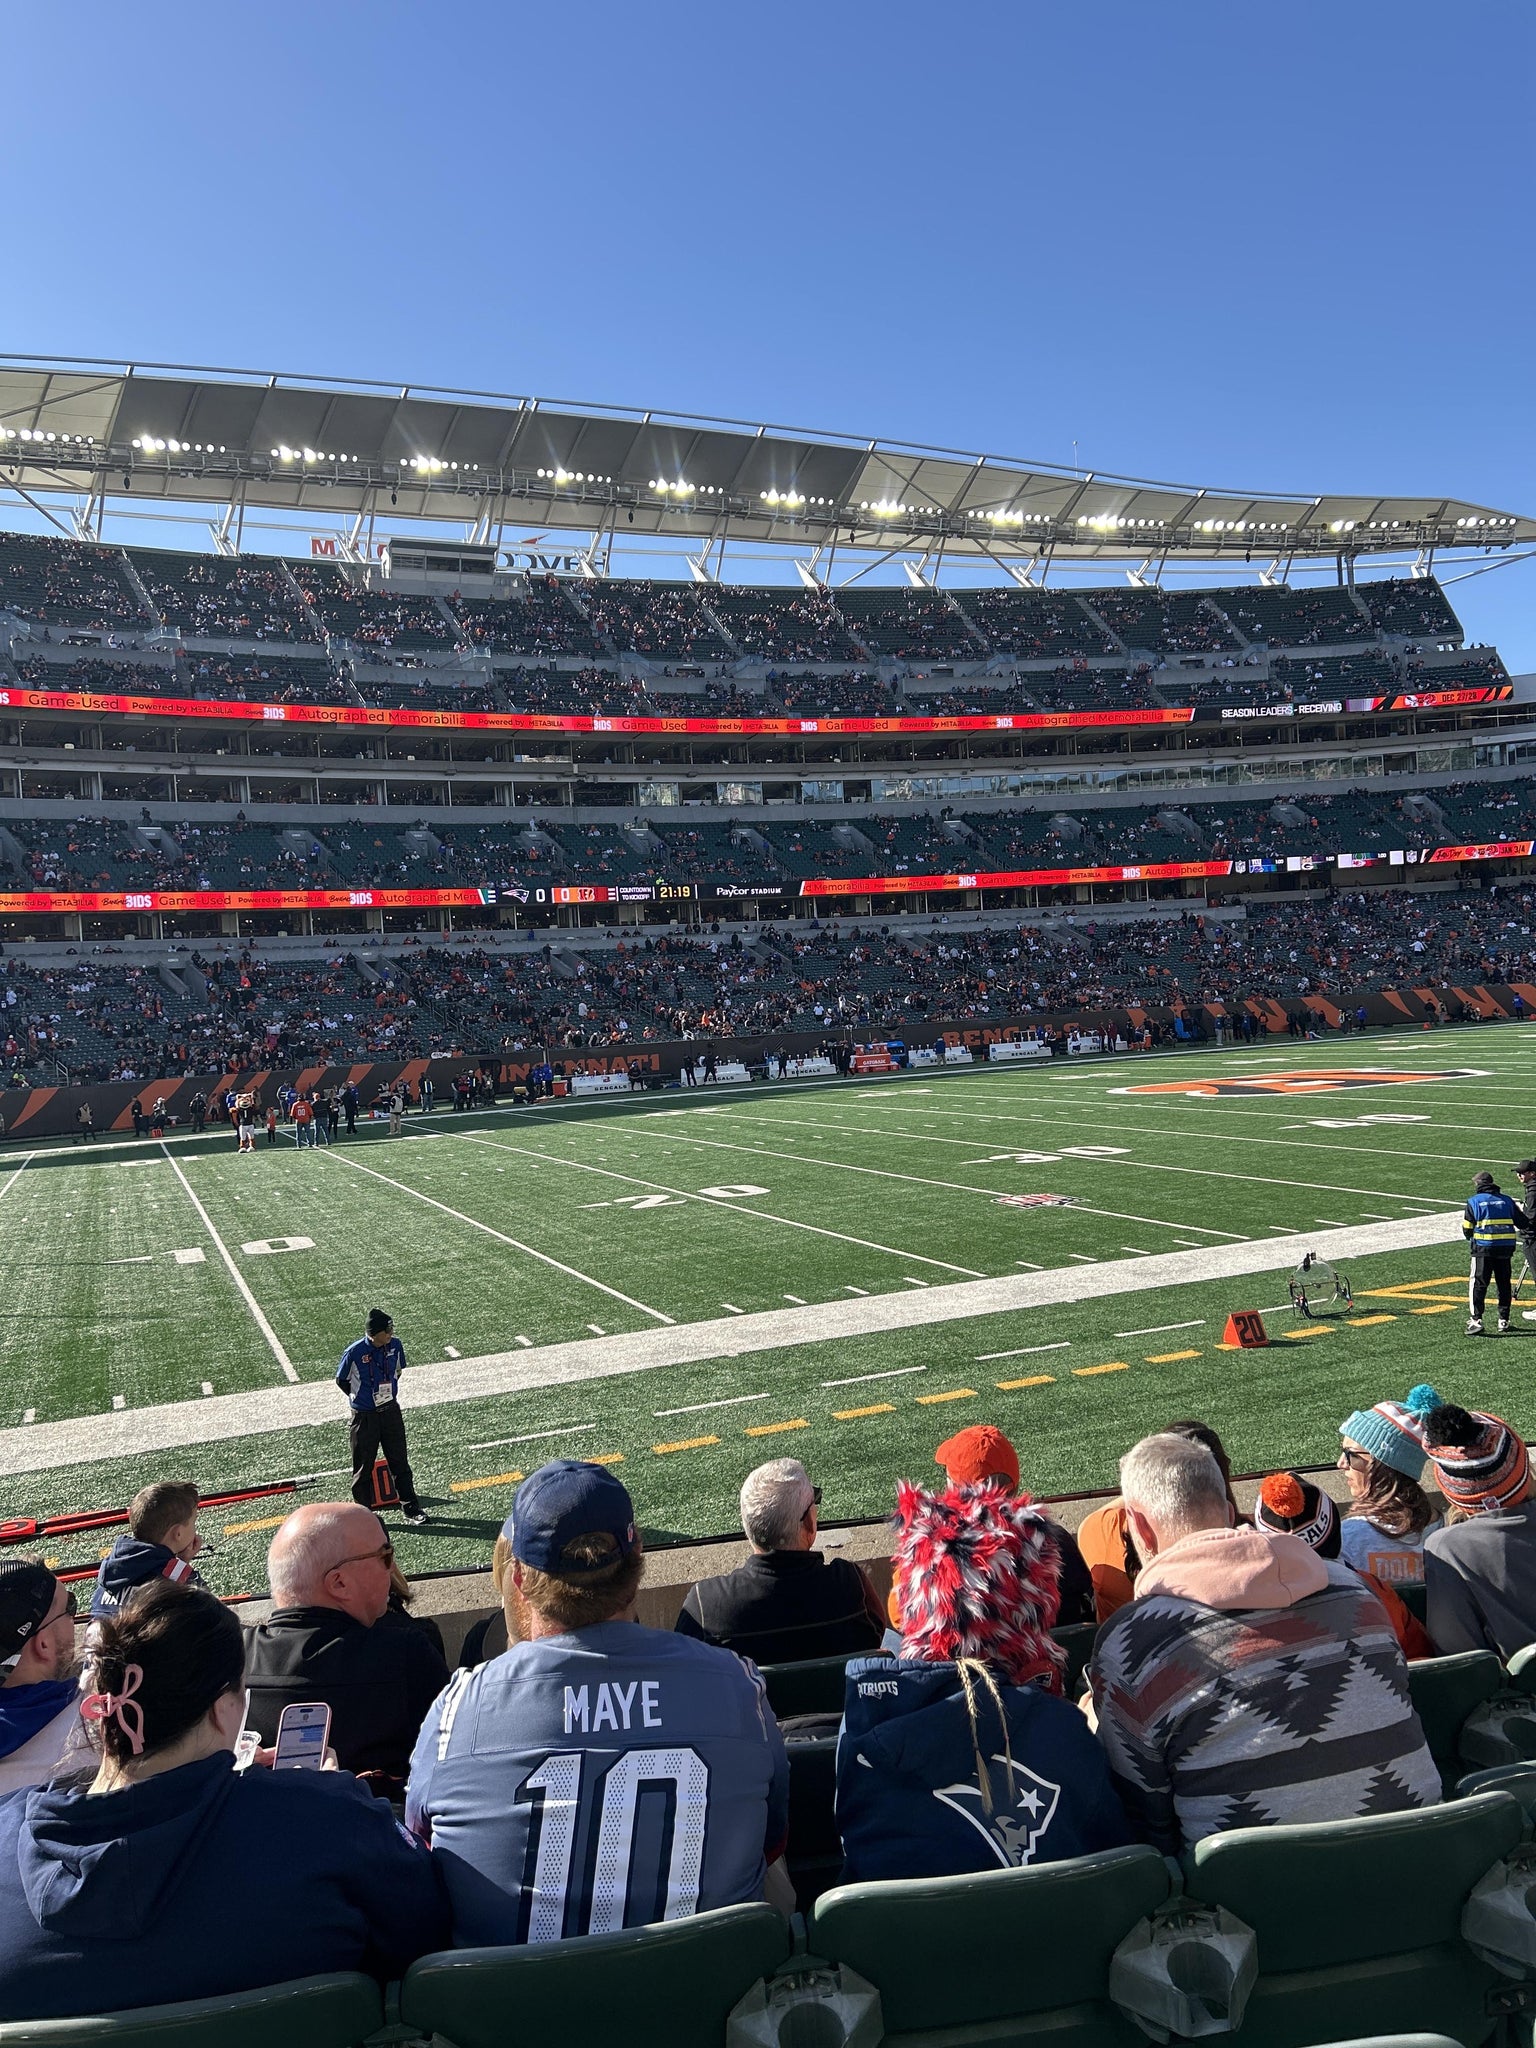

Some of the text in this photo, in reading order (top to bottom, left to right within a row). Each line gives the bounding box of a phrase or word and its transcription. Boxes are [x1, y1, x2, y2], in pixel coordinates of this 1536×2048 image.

[29, 693, 119, 710] Game-Used
[1442, 694, 1455, 703] DEC
[132, 702, 174, 711] Powered
[176, 704, 187, 713] by
[1221, 706, 1255, 718] SEASON
[1256, 704, 1293, 717] LEADERS
[1299, 702, 1343, 714] RECEIVING
[297, 708, 466, 725] Autographed Memorabilia
[478, 718, 513, 726] Powered
[515, 719, 524, 727] by
[1025, 713, 1095, 726] Autographed
[1098, 711, 1163, 723] Memorabilia
[622, 720, 688, 731] Game-Used
[733, 723, 742, 731] by
[825, 720, 888, 731] Game-Used
[1145, 864, 1203, 877] Autographed
[981, 874, 1033, 885] Game-Used
[619, 886, 652, 894] COUNTDOWN
[660, 886, 690, 898] 21:19
[717, 884, 782, 898] Paycor STADIUM
[814, 881, 869, 892] Memorabilia
[159, 895, 231, 906] Game-Used
[238, 896, 272, 904] Powered
[274, 896, 282, 905] by
[378, 892, 455, 906] Autographed
[536, 888, 546, 902] 0
[561, 888, 570, 901] 0
[37, 899, 47, 908] by
[612, 1184, 772, 1210] 20
[1234, 1313, 1266, 1345] 20
[562, 1680, 663, 1734] MAYE
[514, 1744, 712, 1945] 10
